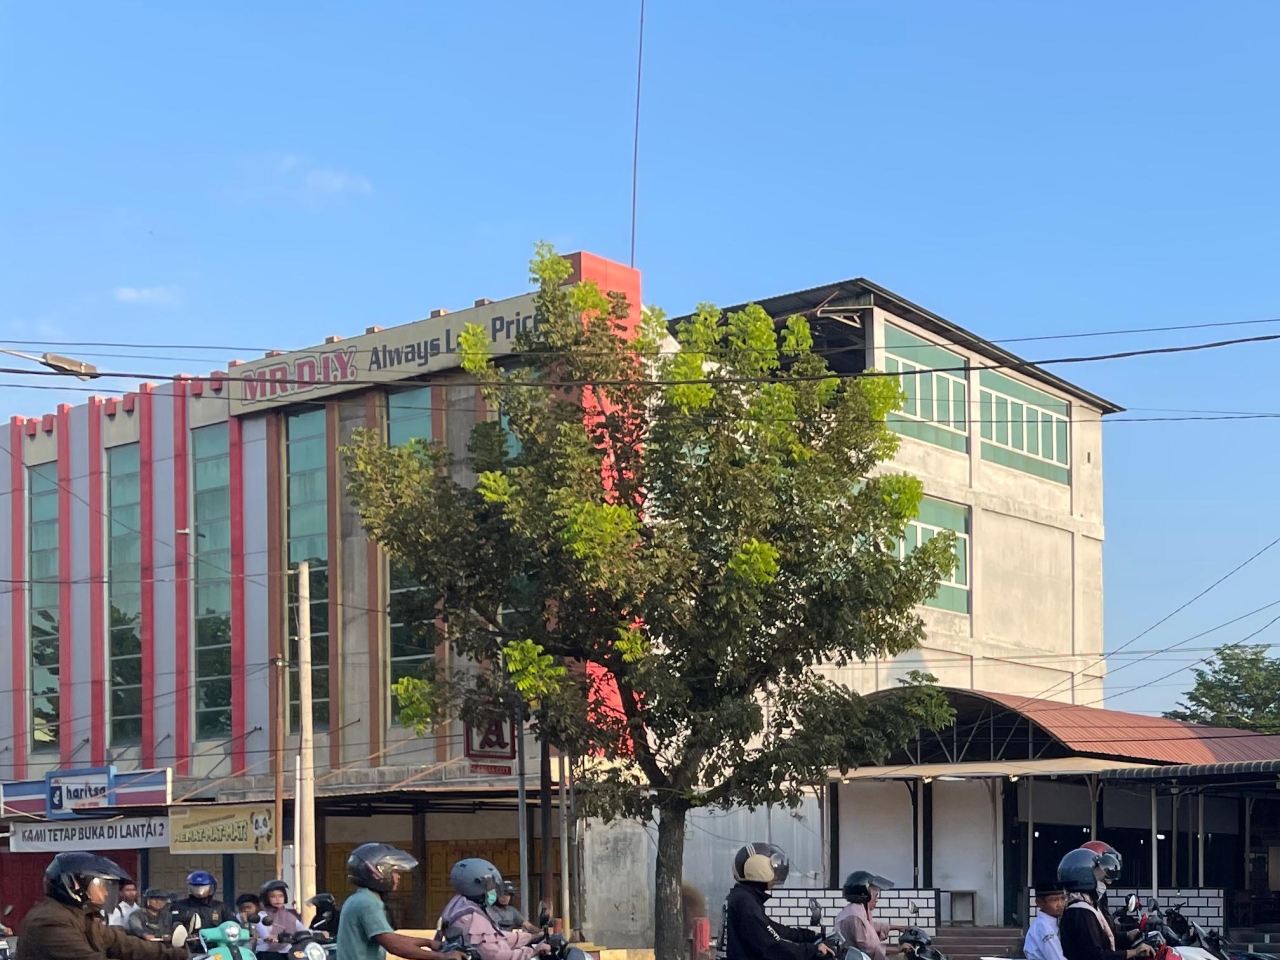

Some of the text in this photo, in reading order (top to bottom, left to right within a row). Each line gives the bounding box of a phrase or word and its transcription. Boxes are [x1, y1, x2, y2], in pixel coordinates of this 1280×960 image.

[368, 336, 441, 372] Always
[66, 784, 107, 800] haritsa
[21, 823, 165, 842] KAMI TETAP BUKA DI LANTAI 2
